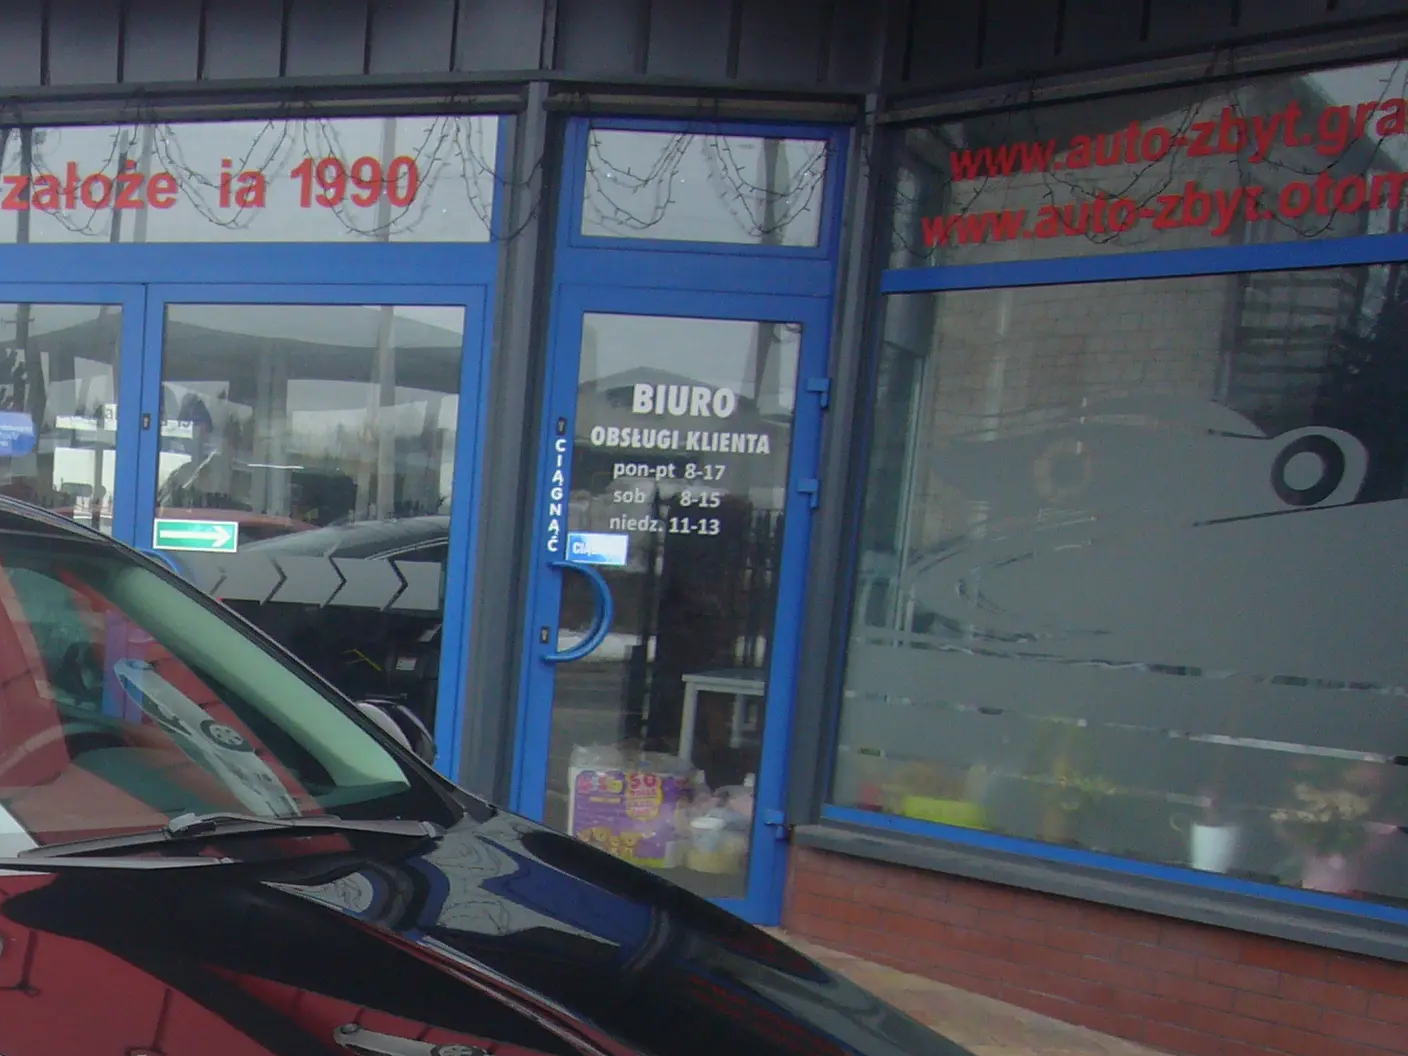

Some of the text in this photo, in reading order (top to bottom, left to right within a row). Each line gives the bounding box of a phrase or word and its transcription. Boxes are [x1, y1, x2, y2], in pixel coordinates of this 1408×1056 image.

[291, 155, 419, 209] 1990
[632, 383, 736, 419] BIURO
[590, 426, 770, 455] OBSŁUGI KLIENTA
[613, 463, 726, 482] pon-pt 8-17
[547, 438, 567, 553] CIĄGNĄĆ
[613, 488, 722, 508] sob 8-15
[609, 515, 721, 536] niedz. 11-13
